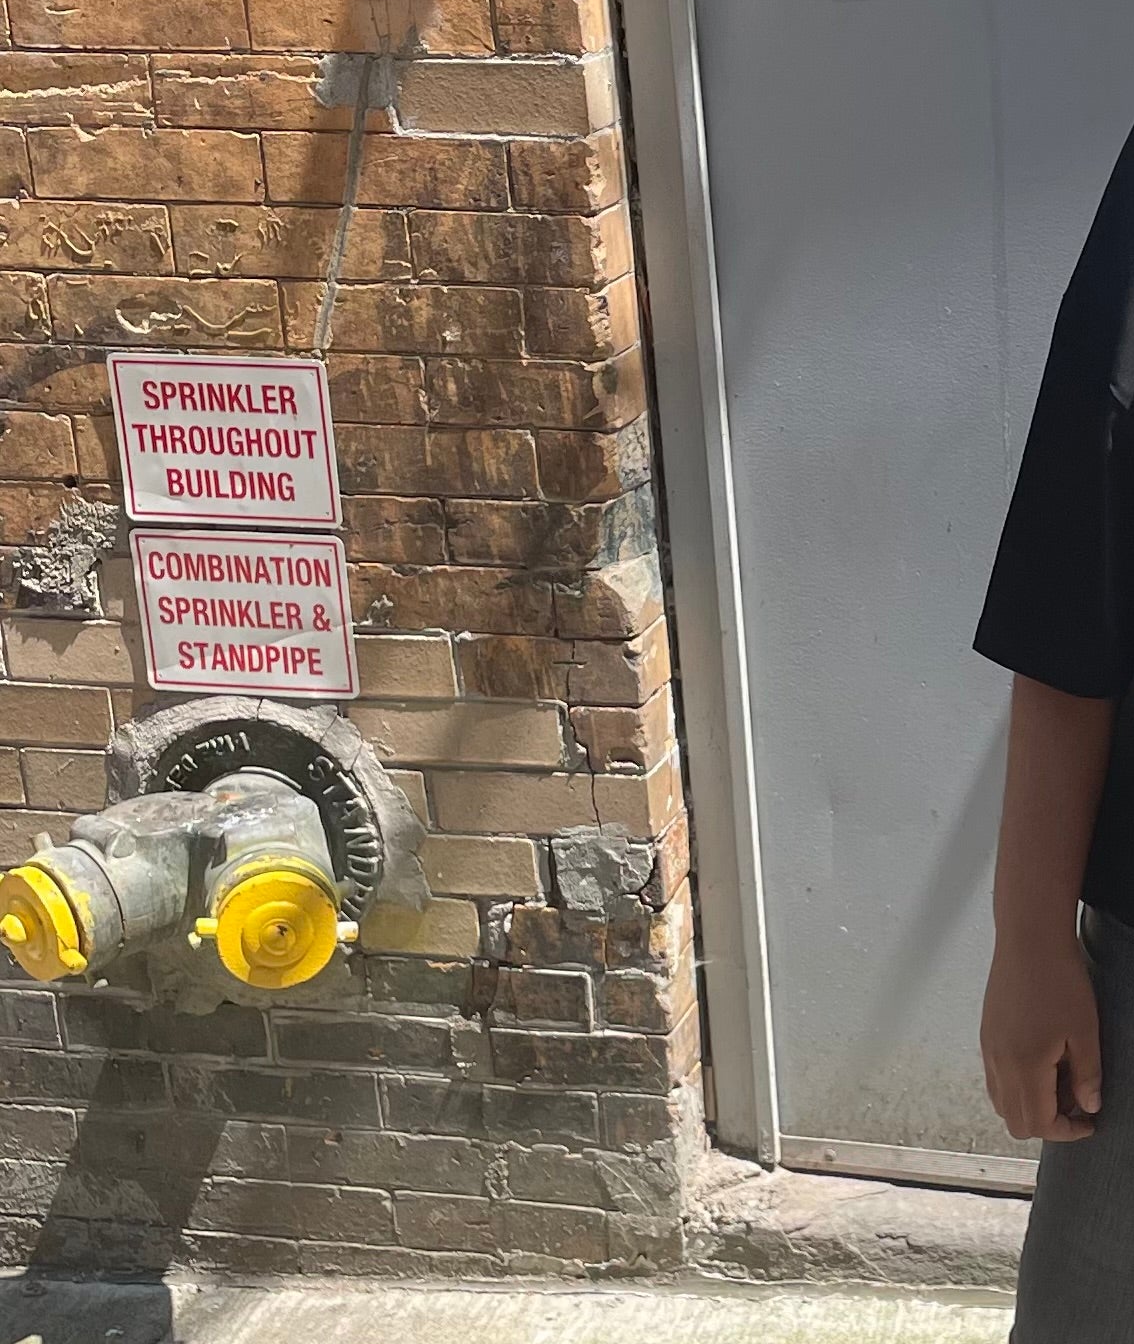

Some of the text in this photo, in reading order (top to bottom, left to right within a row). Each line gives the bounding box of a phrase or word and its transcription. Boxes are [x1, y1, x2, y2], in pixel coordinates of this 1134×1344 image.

[143, 380, 297, 415] SPRINKLER
[132, 422, 316, 459] THROUGHOUT
[166, 467, 295, 501] BUILDING
[147, 551, 332, 587] COMBINATION
[158, 595, 332, 632] SPRINKLER &
[178, 641, 323, 676] STANDPIPE
